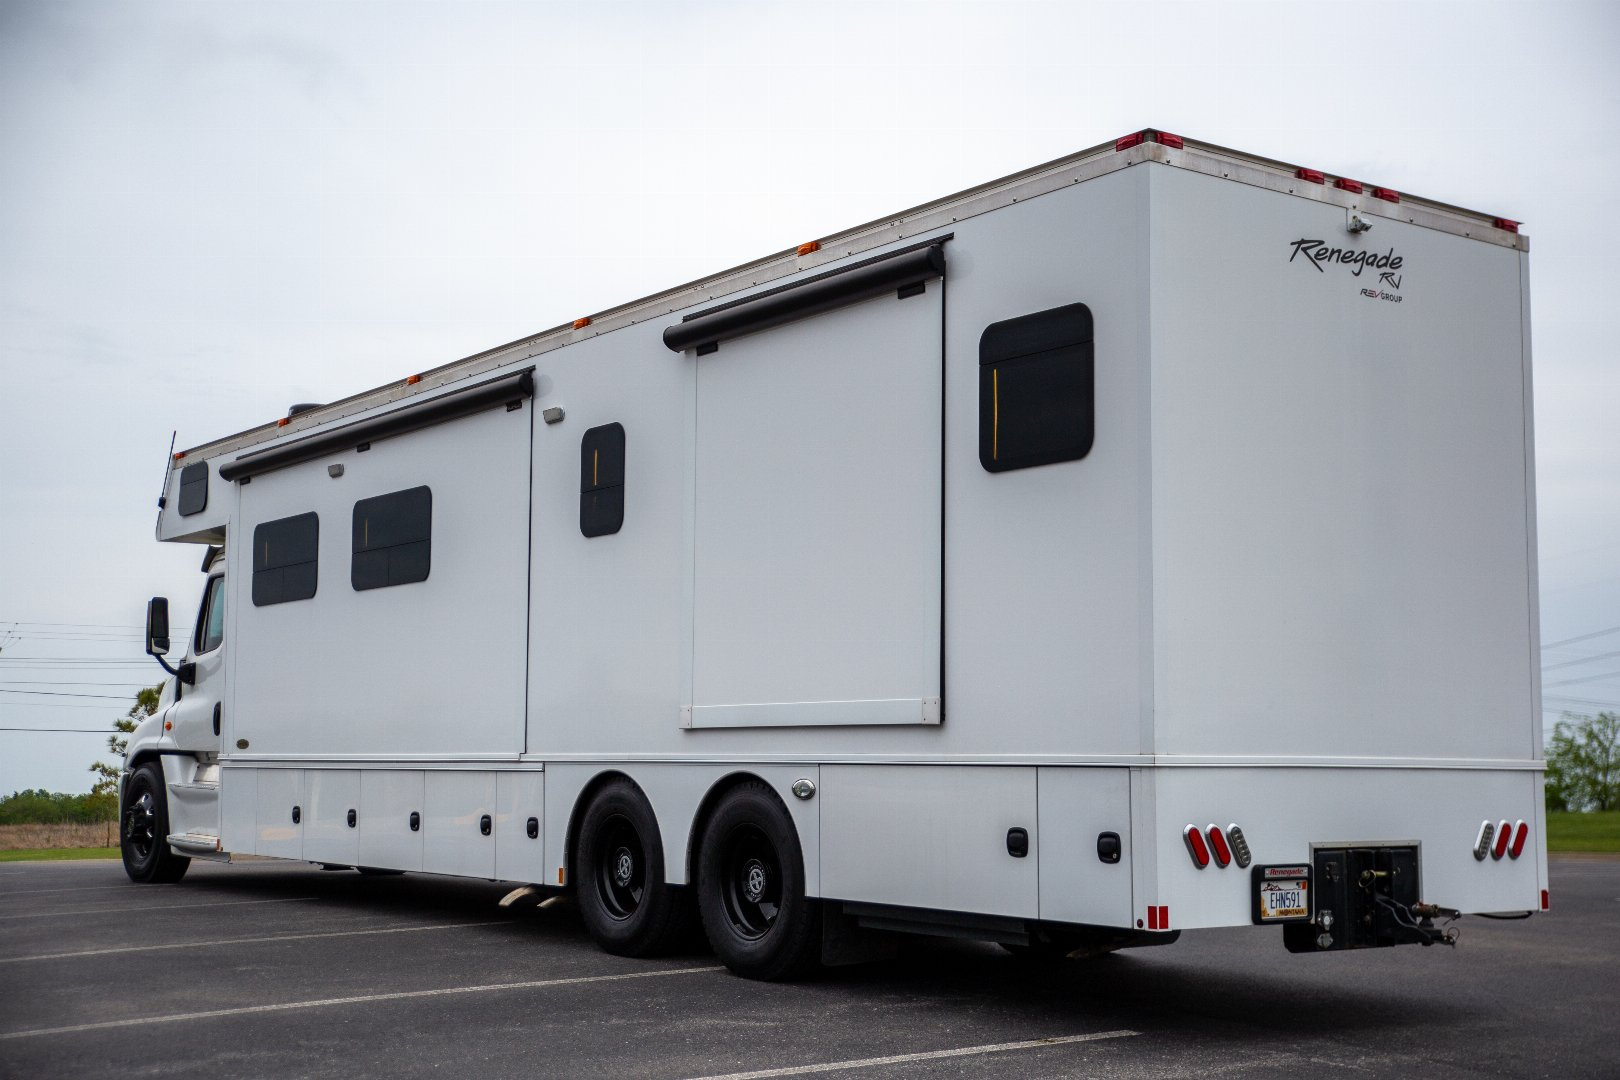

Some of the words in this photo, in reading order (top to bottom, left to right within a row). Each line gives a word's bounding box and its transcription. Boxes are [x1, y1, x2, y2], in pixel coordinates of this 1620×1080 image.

[1290, 238, 1403, 276] Renegade
[1379, 271, 1402, 289] RV
[1269, 868, 1304, 876] Renegade
[1270, 891, 1301, 909] EHN591
